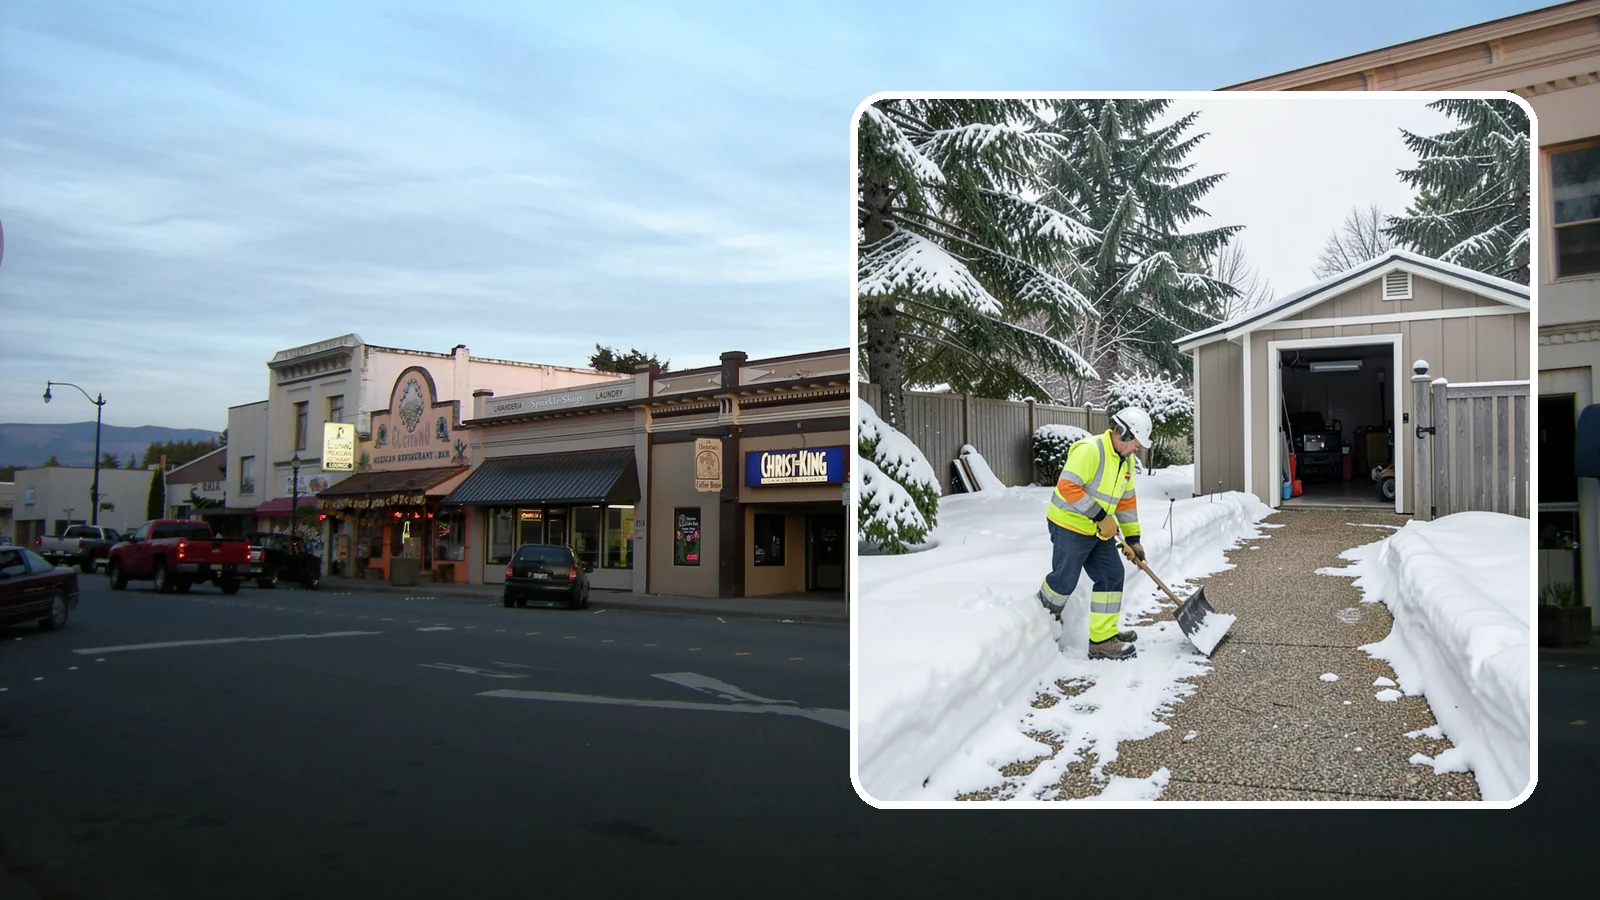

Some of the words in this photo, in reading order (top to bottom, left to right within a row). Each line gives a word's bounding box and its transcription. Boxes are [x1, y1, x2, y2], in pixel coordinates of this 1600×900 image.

[561, 394, 582, 405] Shop
[595, 389, 623, 400] LAUNDRY
[493, 402, 522, 413] LAVANDERIA
[398, 451, 433, 462] RESTAURANT
[438, 450, 450, 459] BAR
[761, 452, 797, 477] CHRIST
[799, 450, 827, 477] KING
[696, 480, 709, 489] Coffee
[710, 481, 722, 489] House
